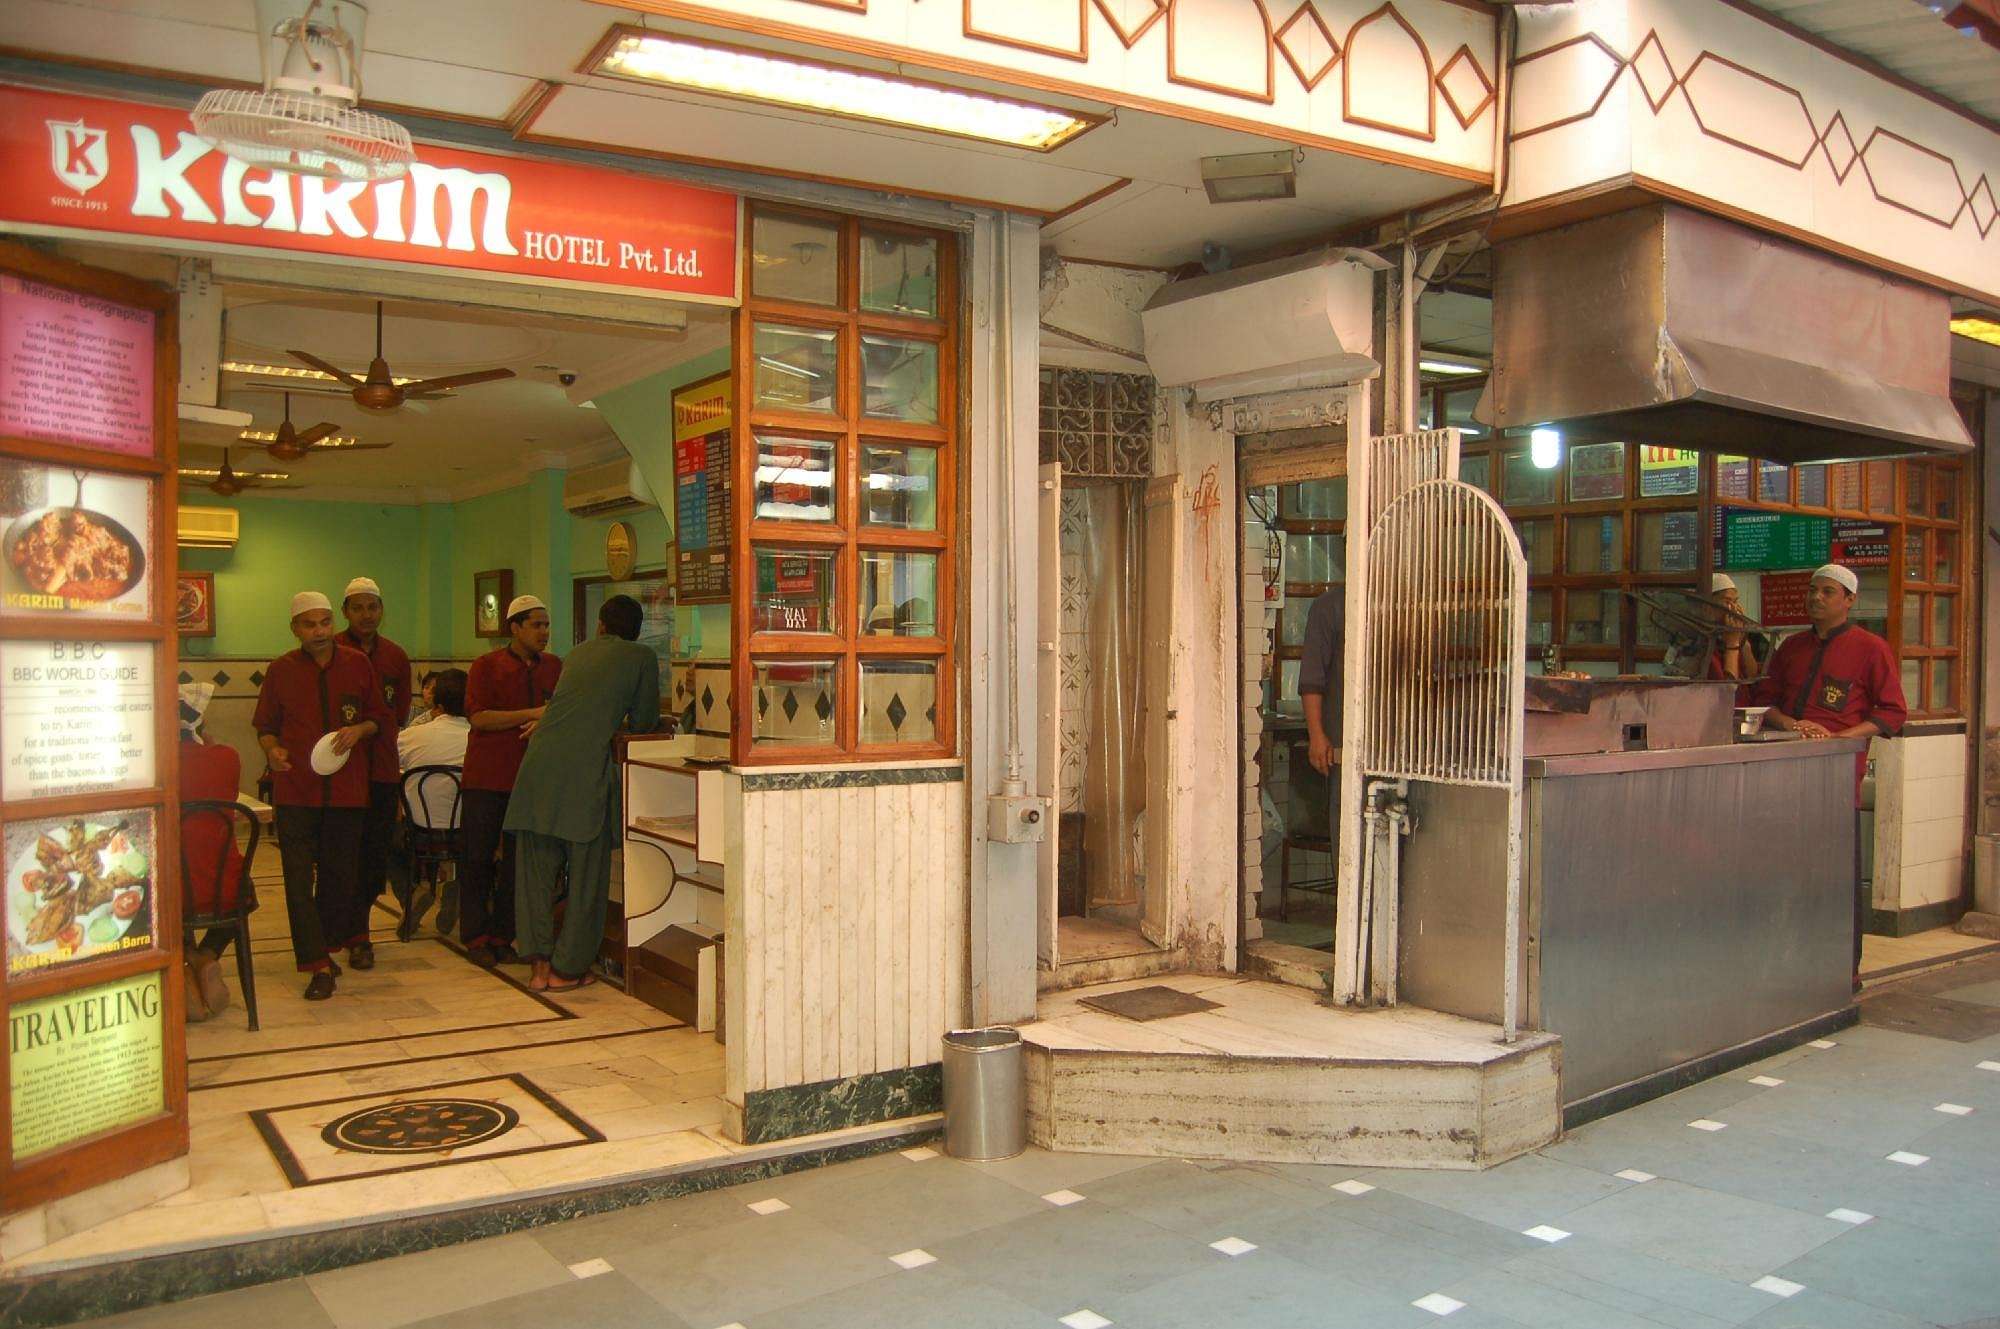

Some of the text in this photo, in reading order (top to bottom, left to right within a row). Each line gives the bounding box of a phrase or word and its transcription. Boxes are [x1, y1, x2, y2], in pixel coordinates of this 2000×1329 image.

[51, 196, 82, 209] SINCE
[524, 231, 610, 268] HOTEL
[619, 242, 658, 273] Pvt.
[664, 247, 704, 278] Ltd.
[21, 279, 75, 306] National
[79, 297, 149, 324] Geographic
[13, 667, 138, 681] BBC WORLD GUIDE
[10, 984, 158, 1053] TRAVELING
